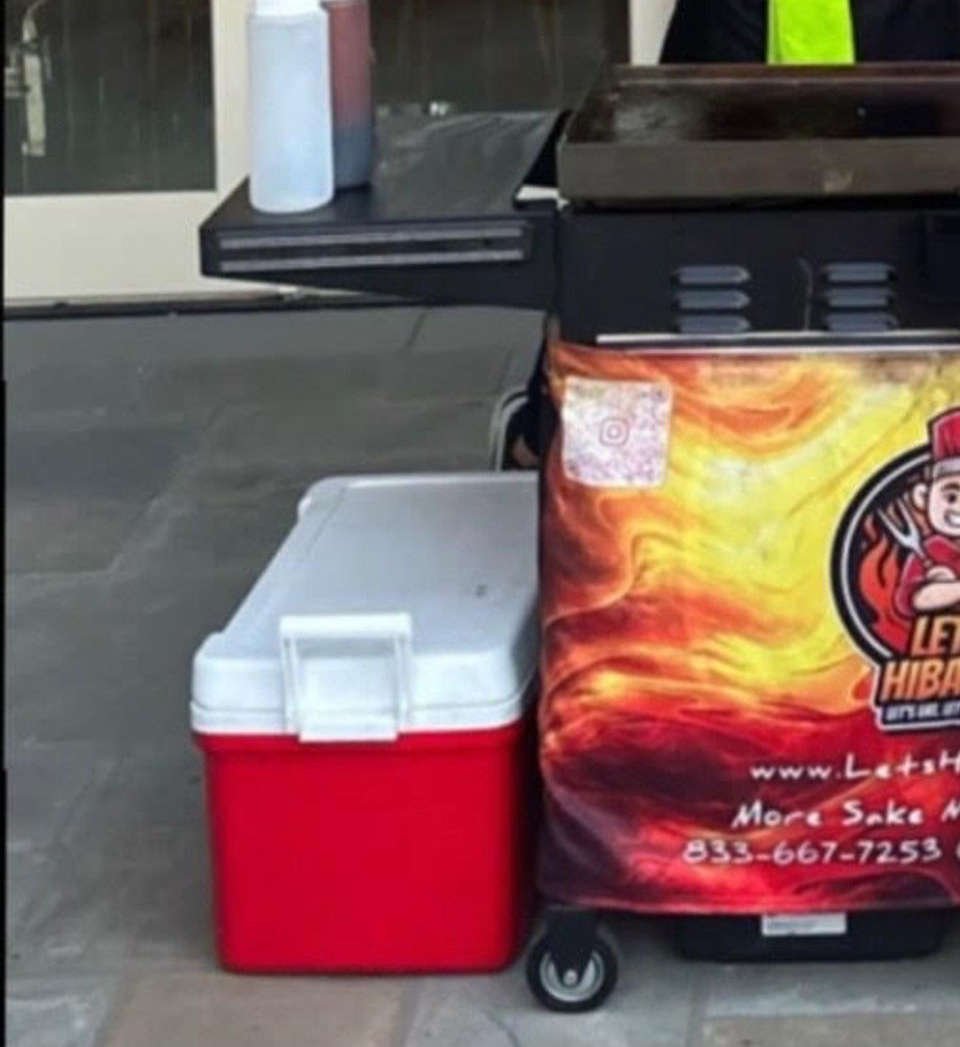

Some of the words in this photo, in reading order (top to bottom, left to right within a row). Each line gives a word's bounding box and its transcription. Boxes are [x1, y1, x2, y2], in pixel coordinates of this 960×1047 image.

[731, 799, 823, 829] More
[841, 799, 924, 827] Sake
[682, 836, 942, 866] 833-667-7253
